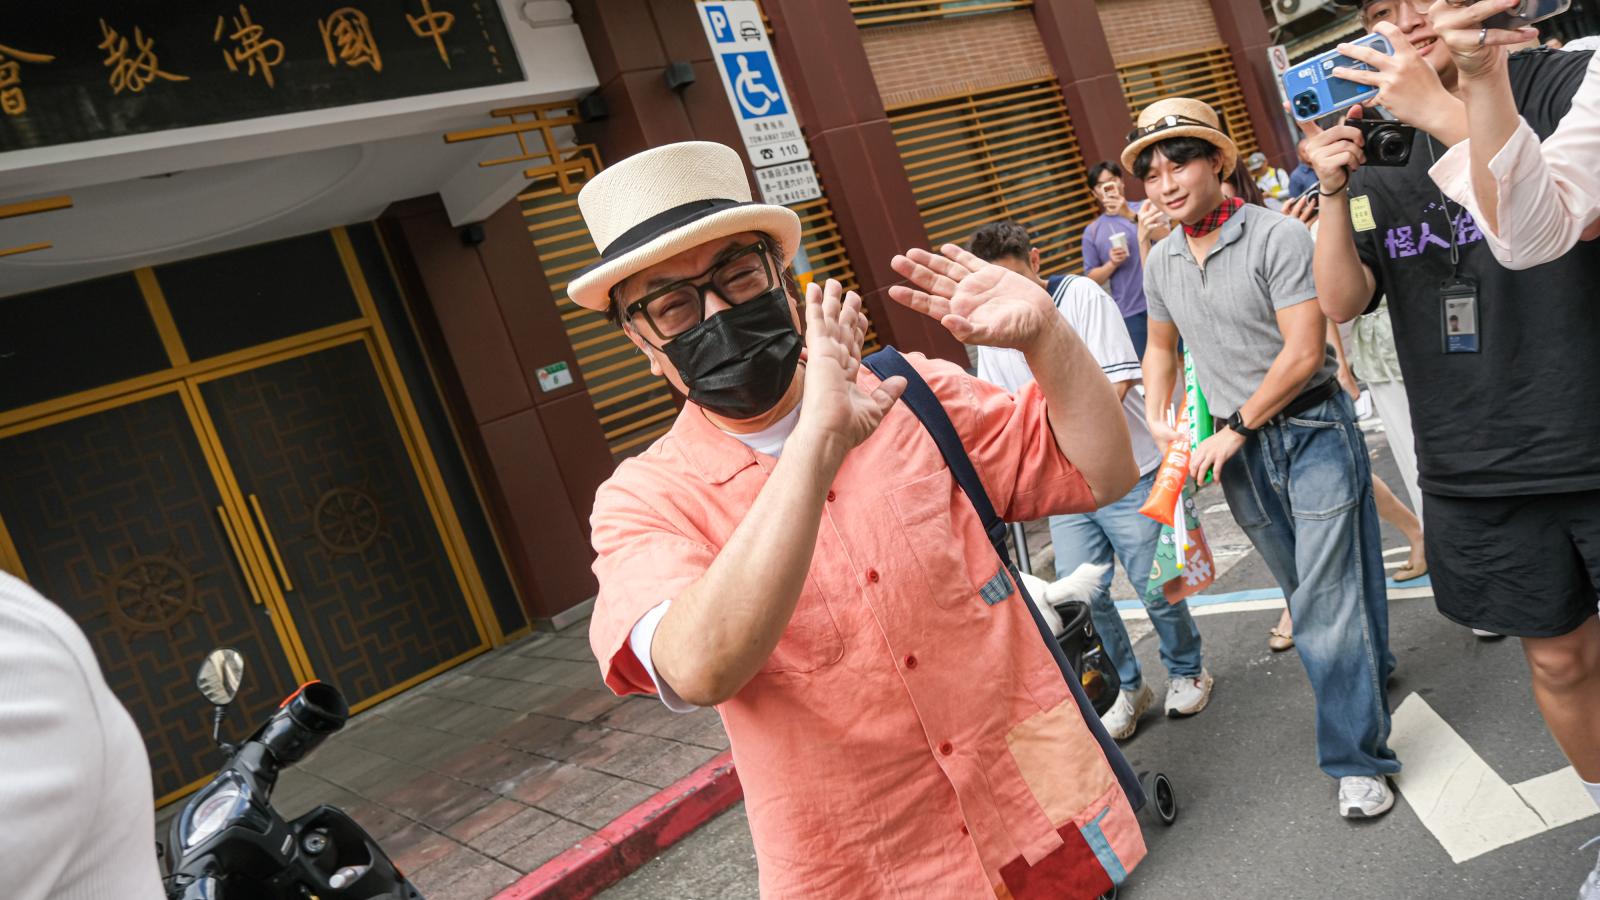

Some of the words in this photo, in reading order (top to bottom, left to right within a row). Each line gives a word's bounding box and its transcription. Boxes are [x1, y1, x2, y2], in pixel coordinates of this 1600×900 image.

[708, 11, 727, 38] P
[780, 130, 796, 139] ZONE
[780, 144, 799, 156] 110
